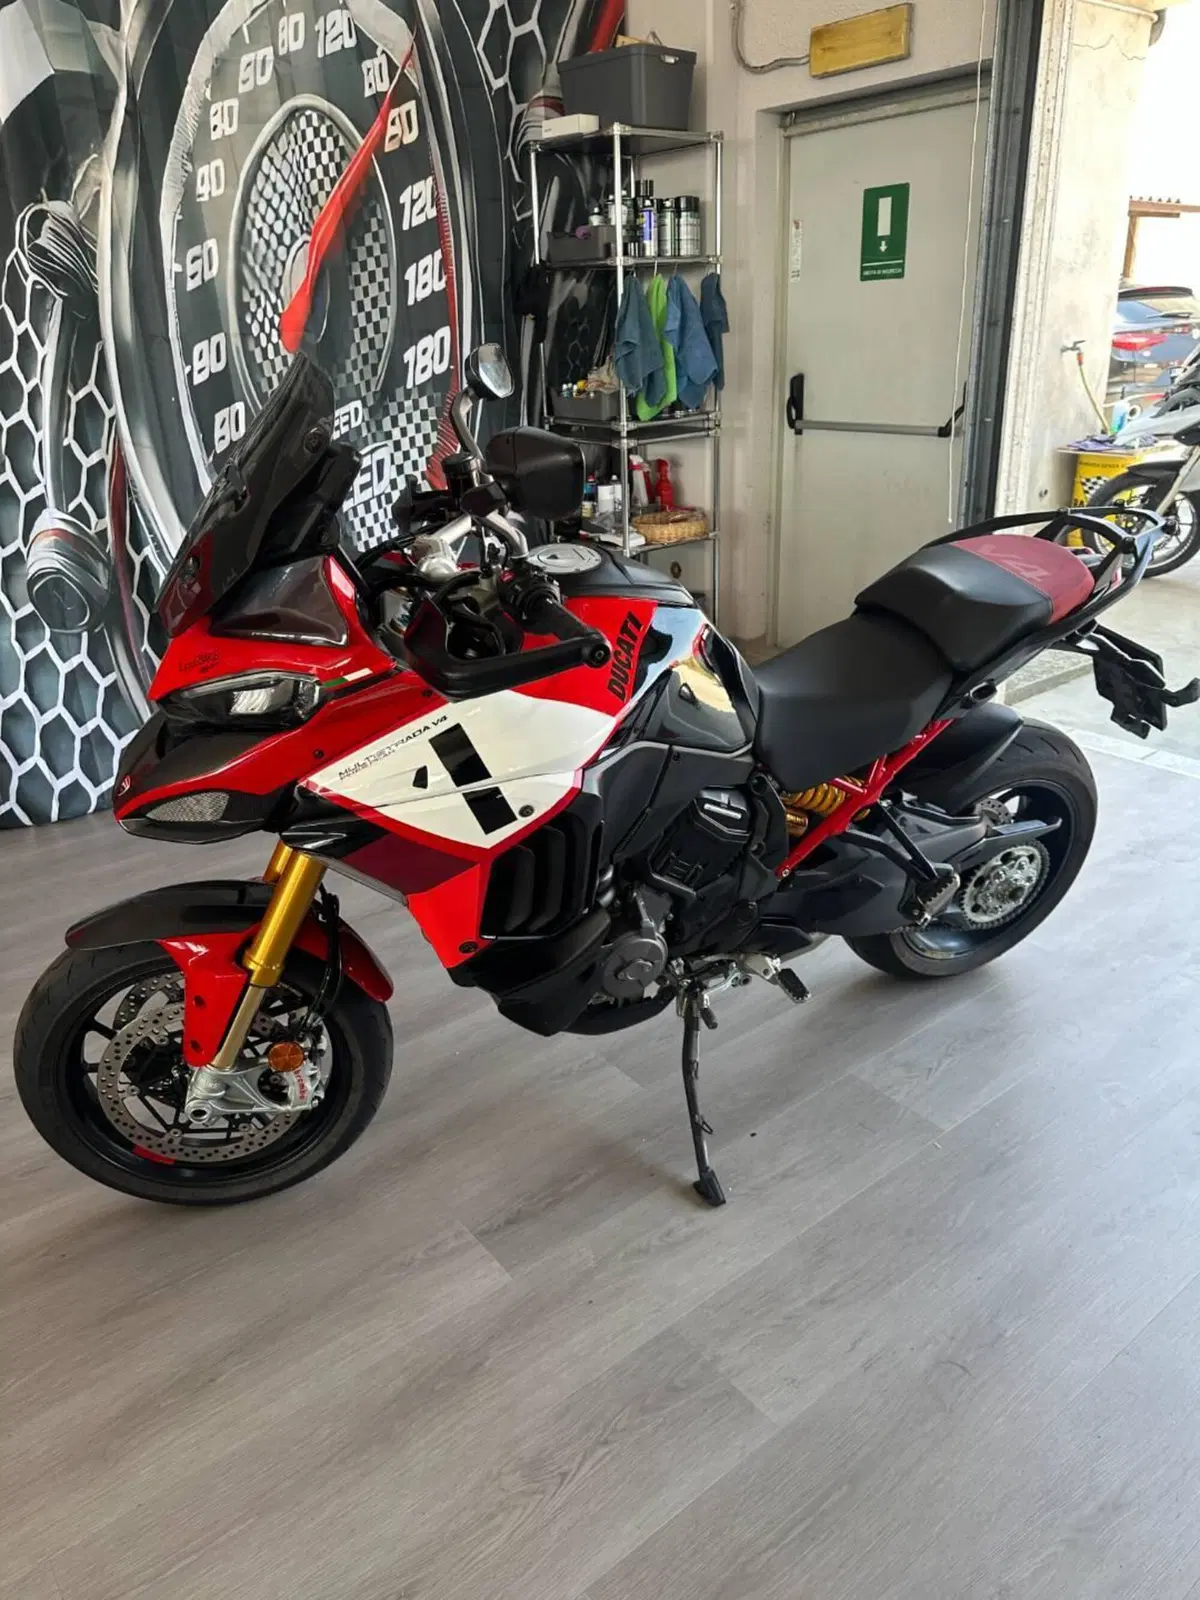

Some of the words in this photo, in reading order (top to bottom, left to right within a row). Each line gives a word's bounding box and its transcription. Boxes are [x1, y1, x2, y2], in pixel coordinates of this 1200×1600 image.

[278, 12, 305, 56] 80
[314, 9, 357, 58] 120
[403, 326, 451, 389] 180
[333, 400, 363, 440] EED
[607, 611, 643, 703] DUCATI
[338, 725, 431, 777] MULTISTRADA
[432, 715, 448, 726] V4
